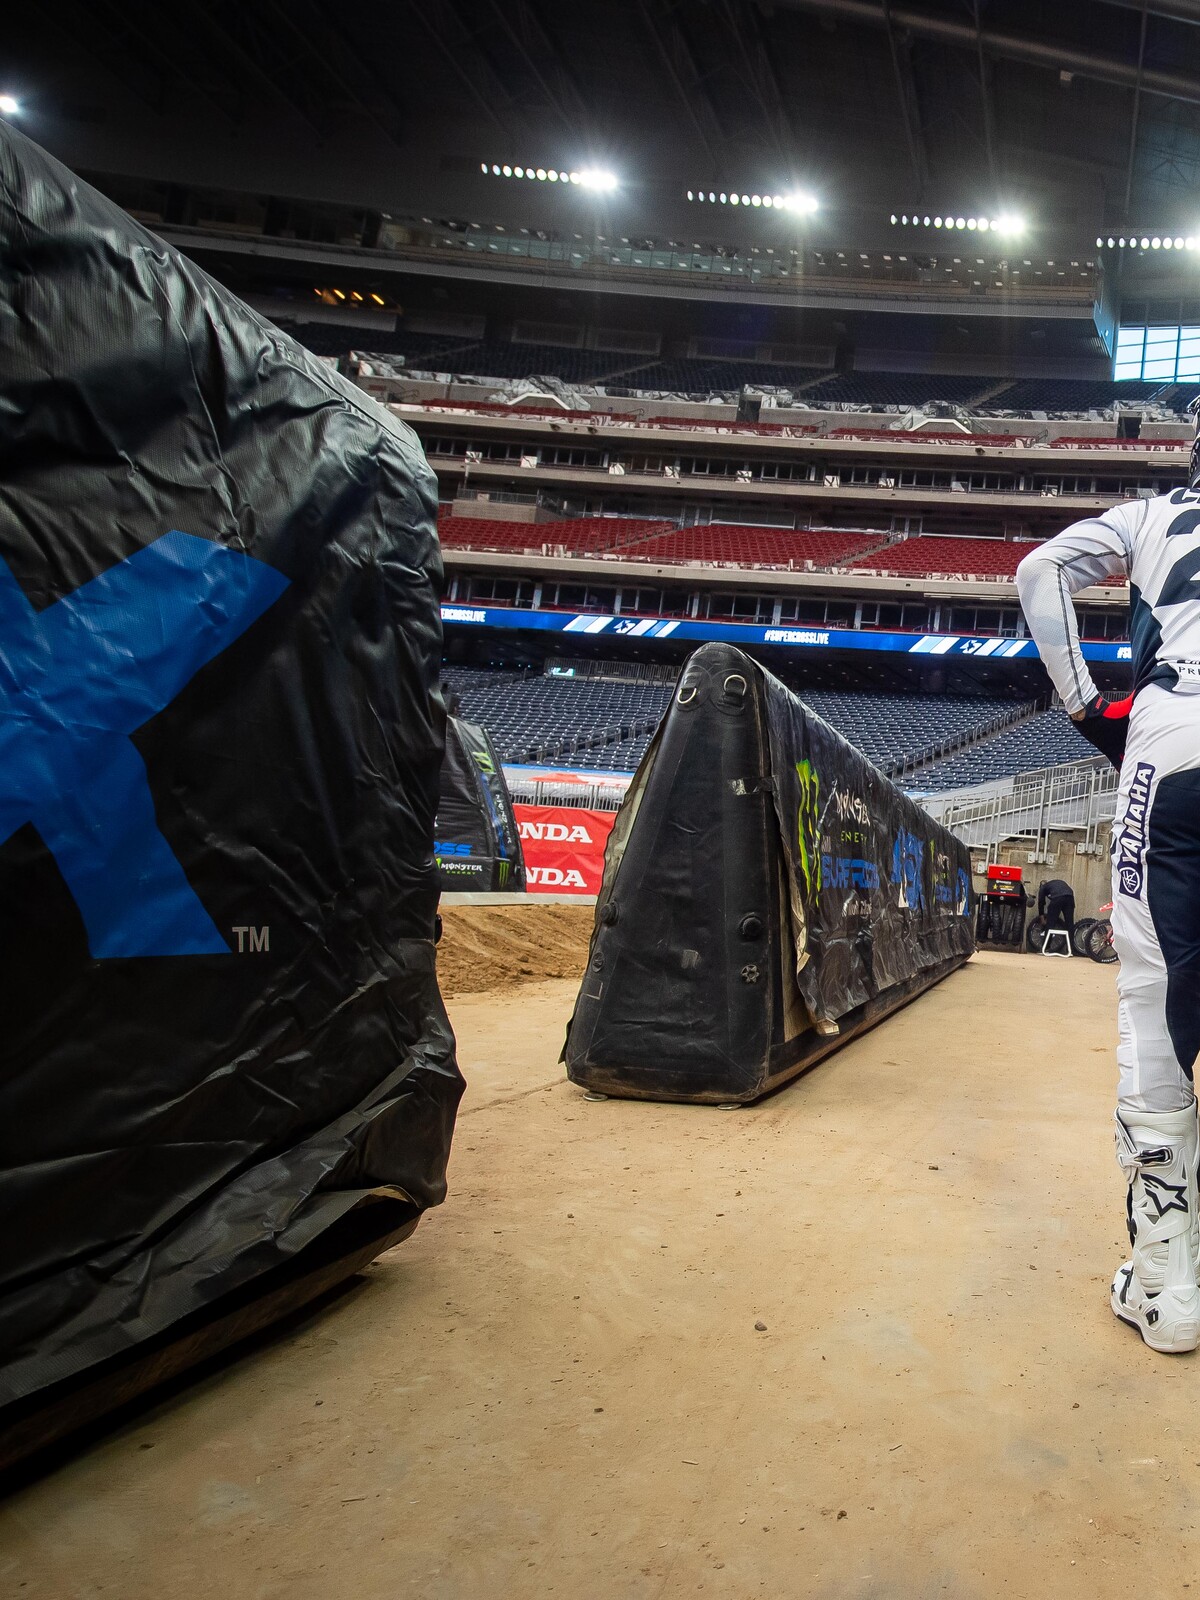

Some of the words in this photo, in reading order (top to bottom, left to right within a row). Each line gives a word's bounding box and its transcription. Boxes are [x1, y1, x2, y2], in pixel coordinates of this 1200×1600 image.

[764, 629, 829, 645] #SUPERCROSSLIVE
[1121, 768, 1153, 864] YAMAHA
[517, 822, 593, 844] NDA
[441, 862, 483, 872] MONSTER
[231, 926, 270, 953] TM
